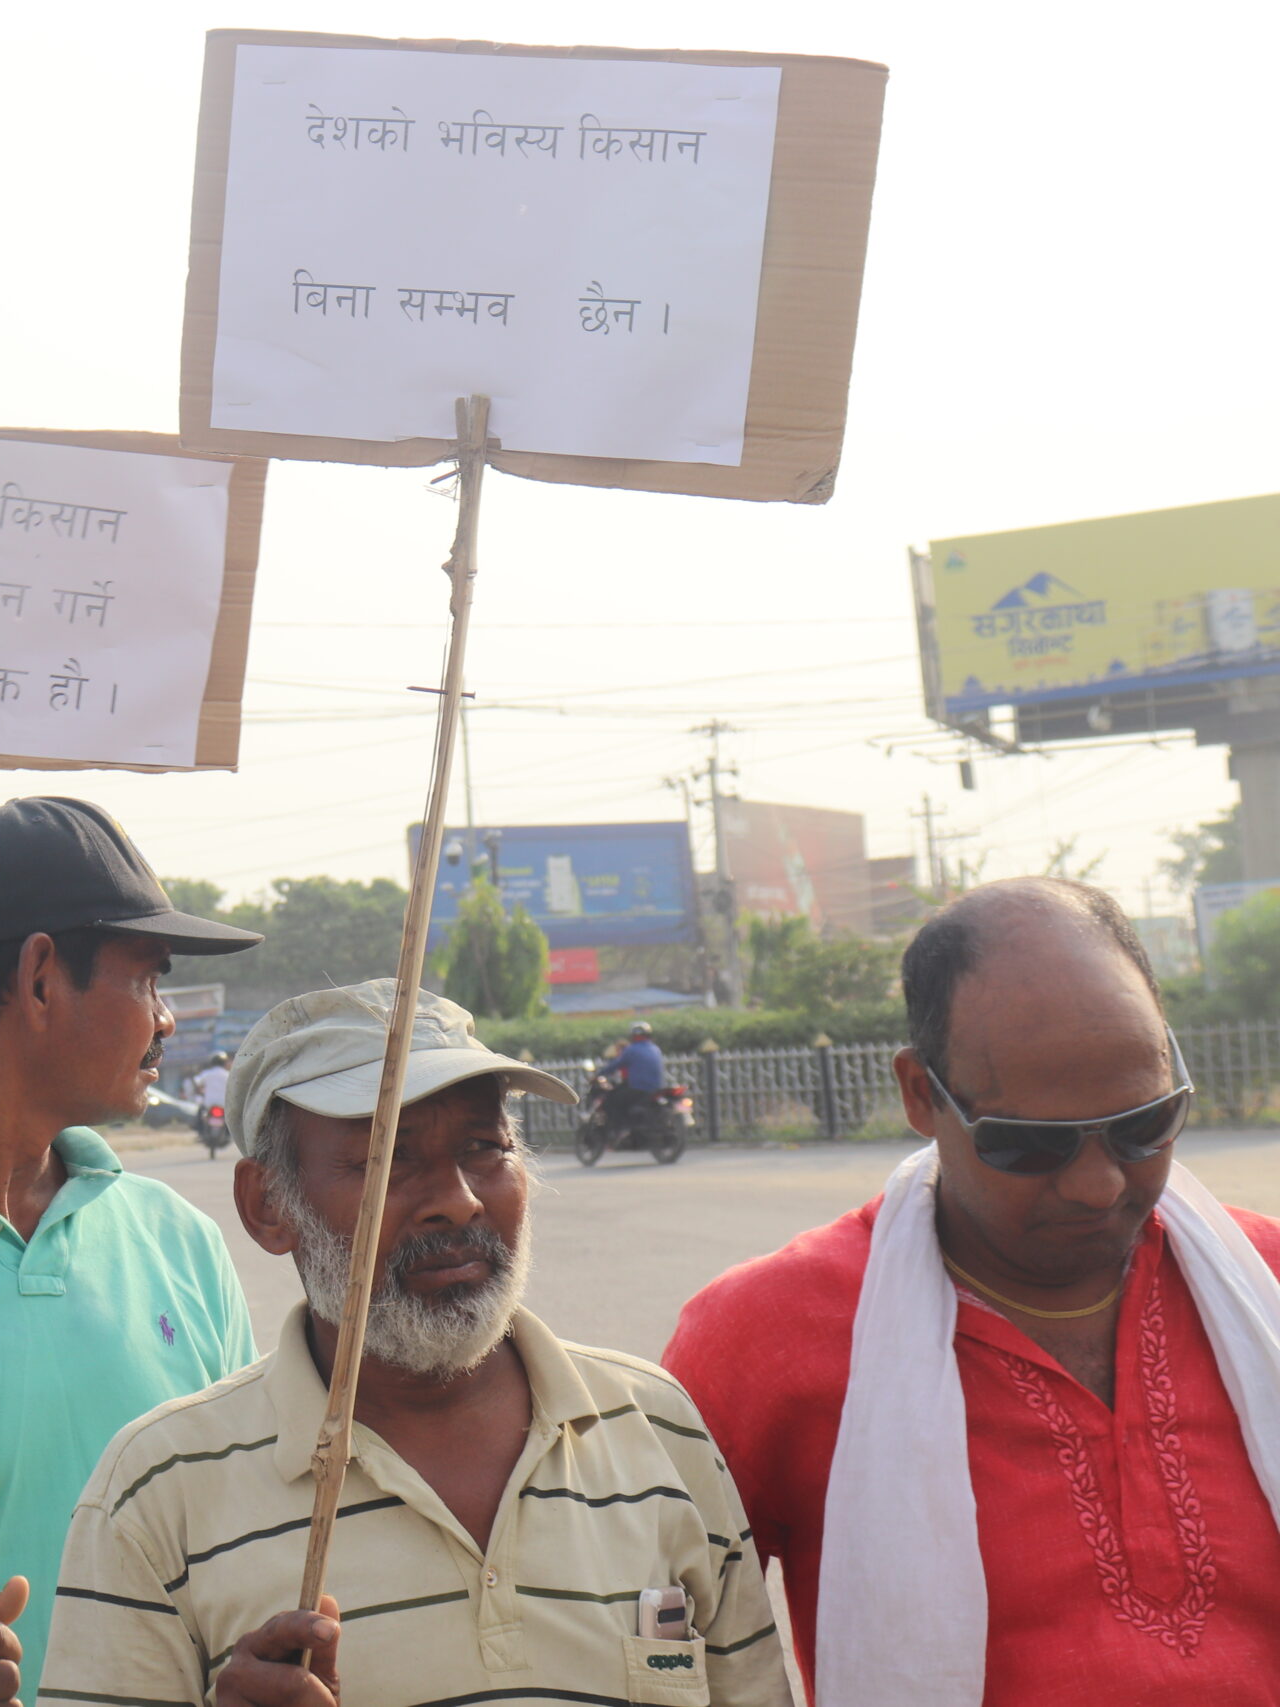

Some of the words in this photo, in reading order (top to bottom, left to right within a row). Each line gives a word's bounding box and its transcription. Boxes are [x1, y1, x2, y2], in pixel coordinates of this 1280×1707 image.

[306, 104, 416, 152] देशको
[438, 109, 565, 159] भविस्य
[578, 112, 707, 164] किसान
[291, 268, 376, 318] बिना
[397, 288, 515, 326] सम्भव
[578, 280, 641, 335] छैन
[52, 580, 115, 628] गर्ने
[49, 657, 91, 711] हौ
